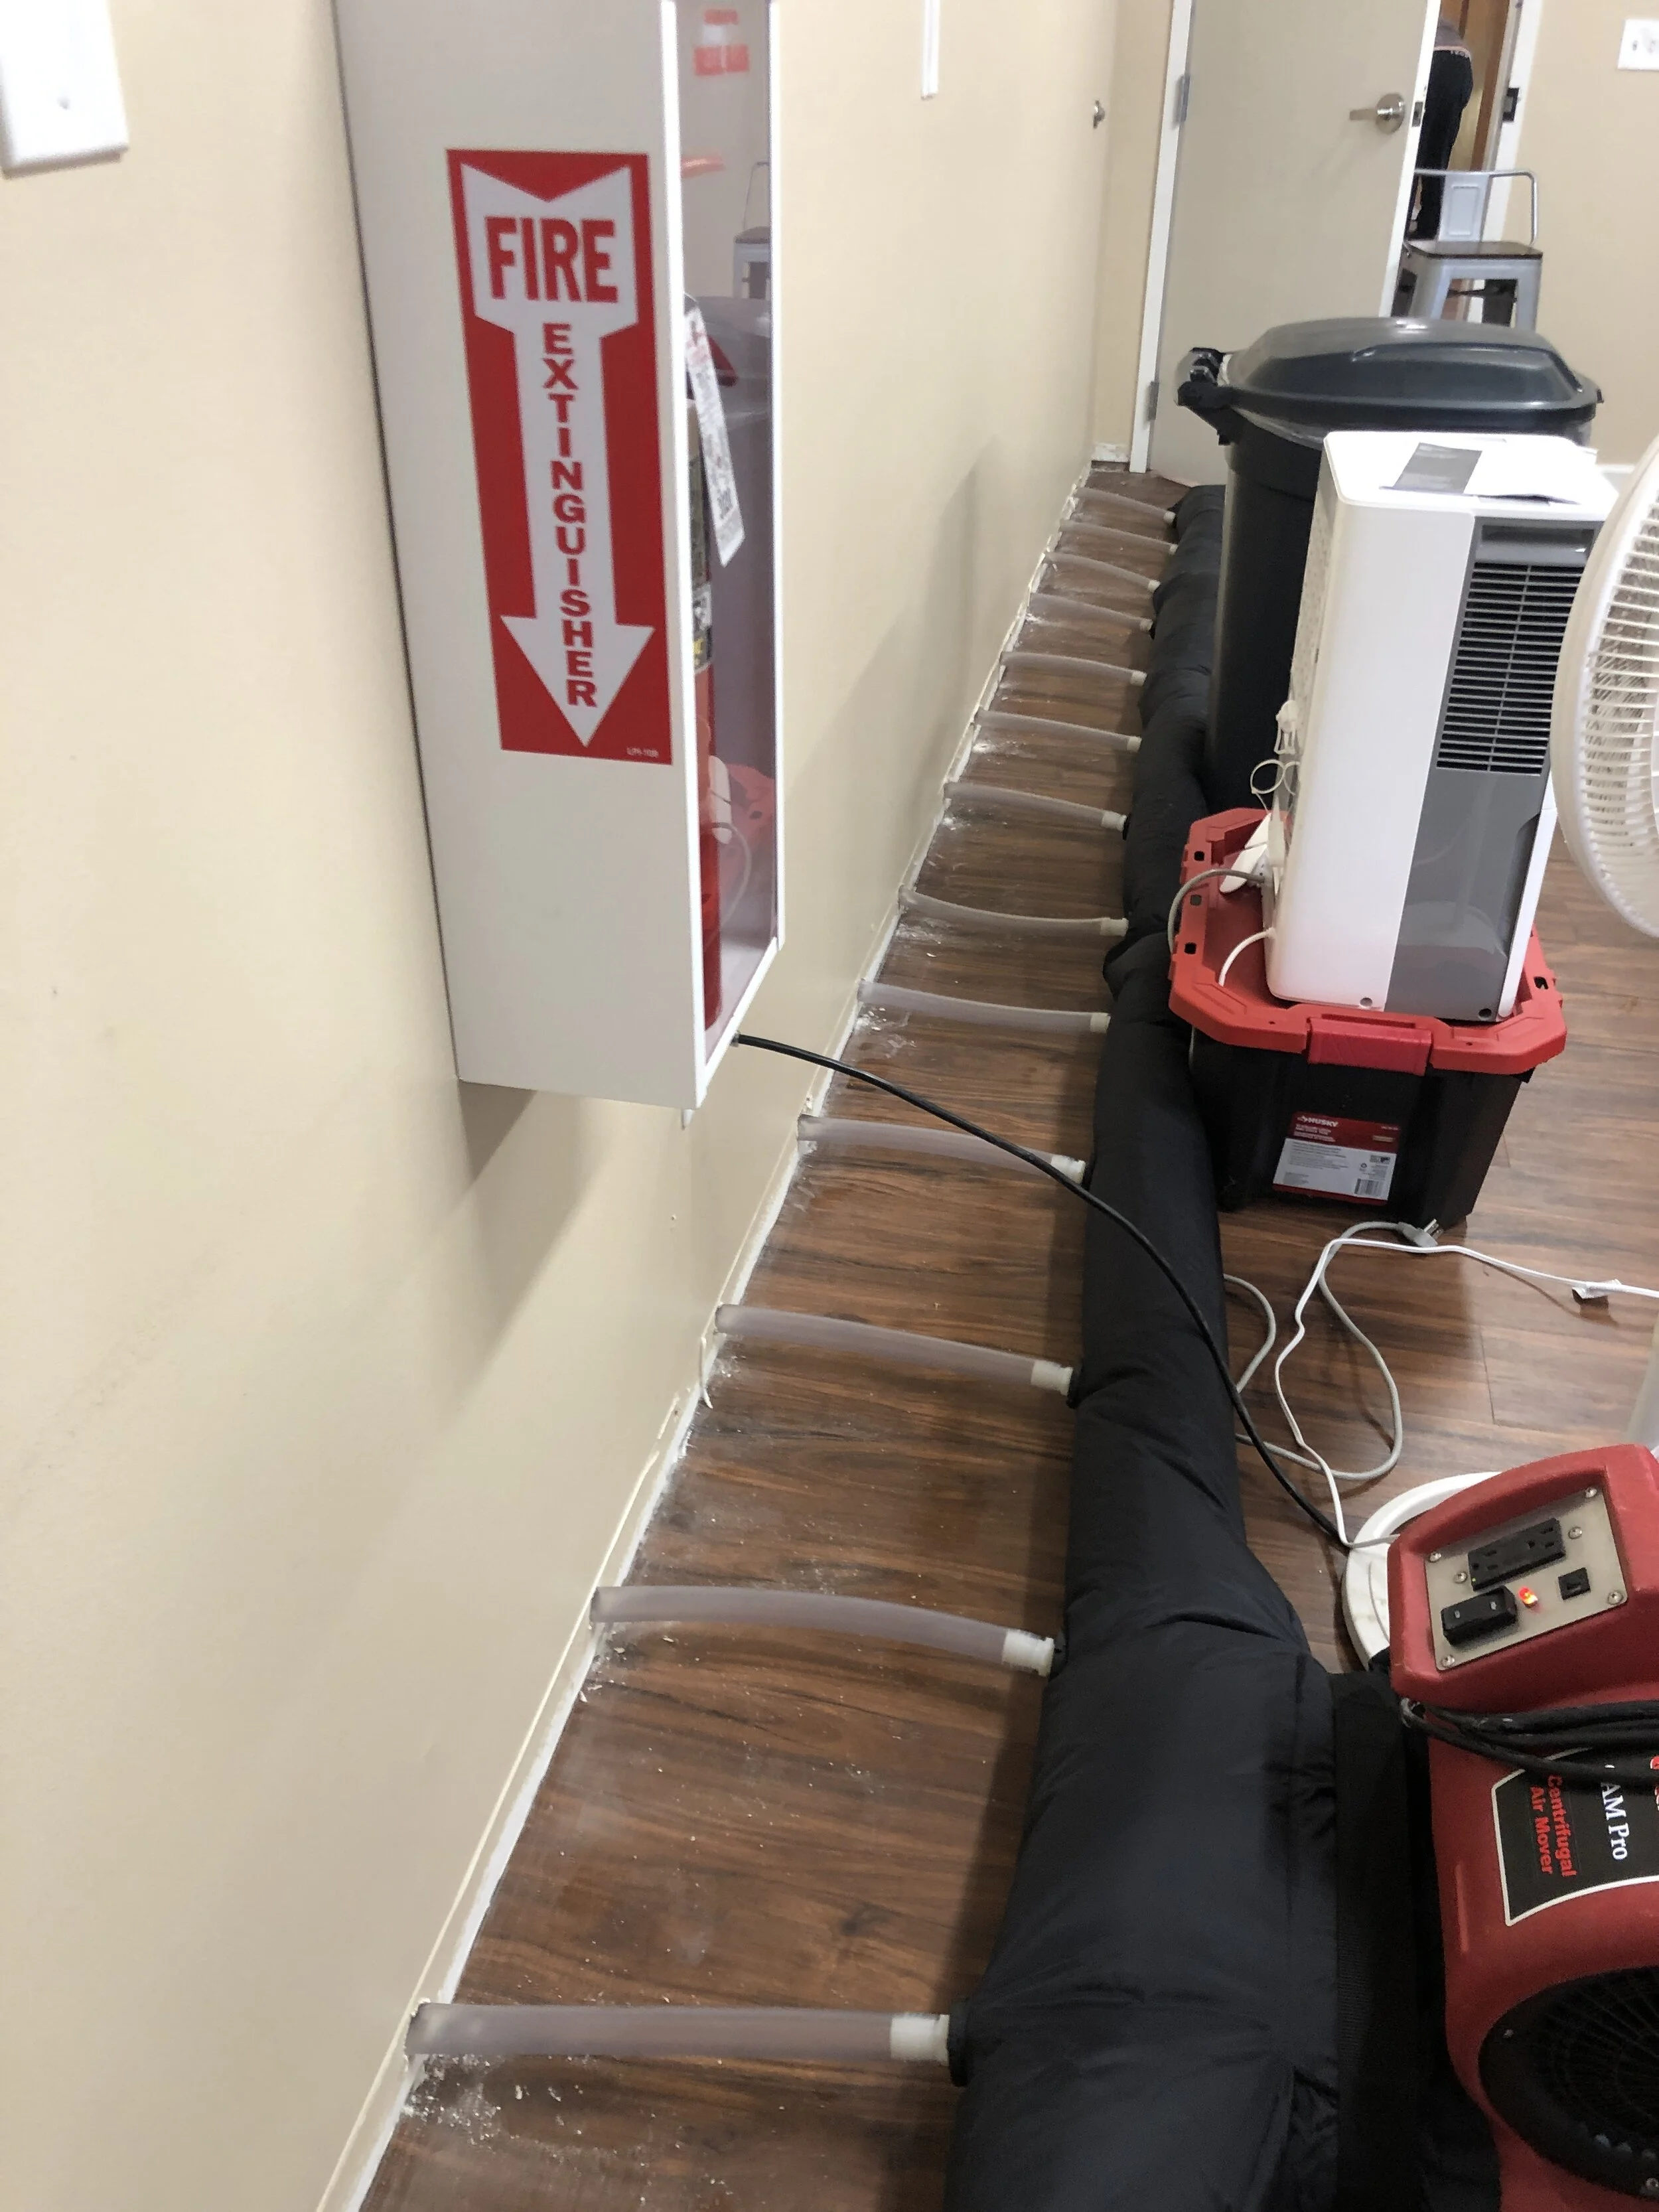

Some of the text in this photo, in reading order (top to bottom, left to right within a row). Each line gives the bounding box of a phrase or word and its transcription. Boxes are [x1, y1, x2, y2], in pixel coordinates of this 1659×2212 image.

[484, 216, 618, 303] FIRE
[542, 322, 598, 708] EXTINGUISHER
[1308, 1117, 1338, 1128] HUSKY
[1530, 1786, 1553, 1875] Air Mover
[1548, 1775, 1577, 1877] Centrifugal
[1608, 1822, 1630, 1861] Pro
